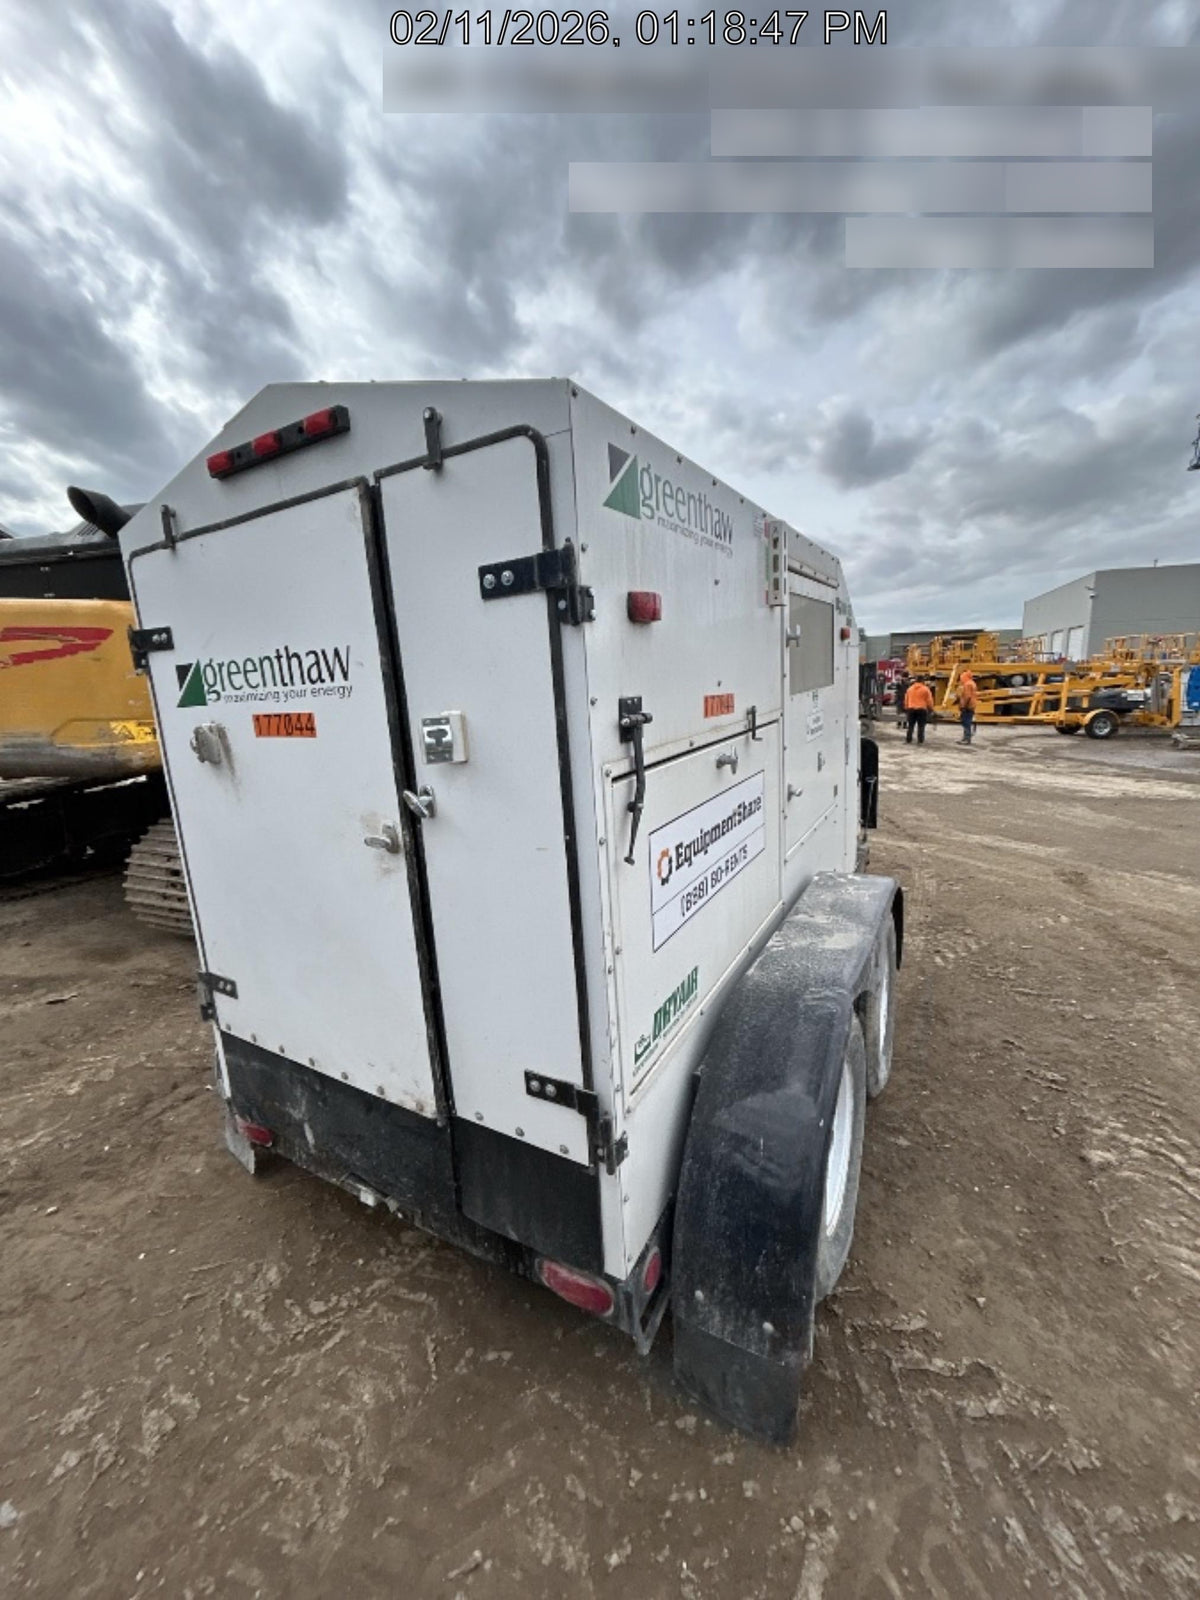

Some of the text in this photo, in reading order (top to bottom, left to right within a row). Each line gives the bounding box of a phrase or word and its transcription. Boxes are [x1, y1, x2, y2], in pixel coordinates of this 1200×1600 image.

[640, 462, 733, 545] greenthaw
[203, 645, 350, 702] greenthaw
[283, 687, 308, 703] your
[310, 684, 353, 700] energy
[674, 795, 763, 872] EquipmentShare
